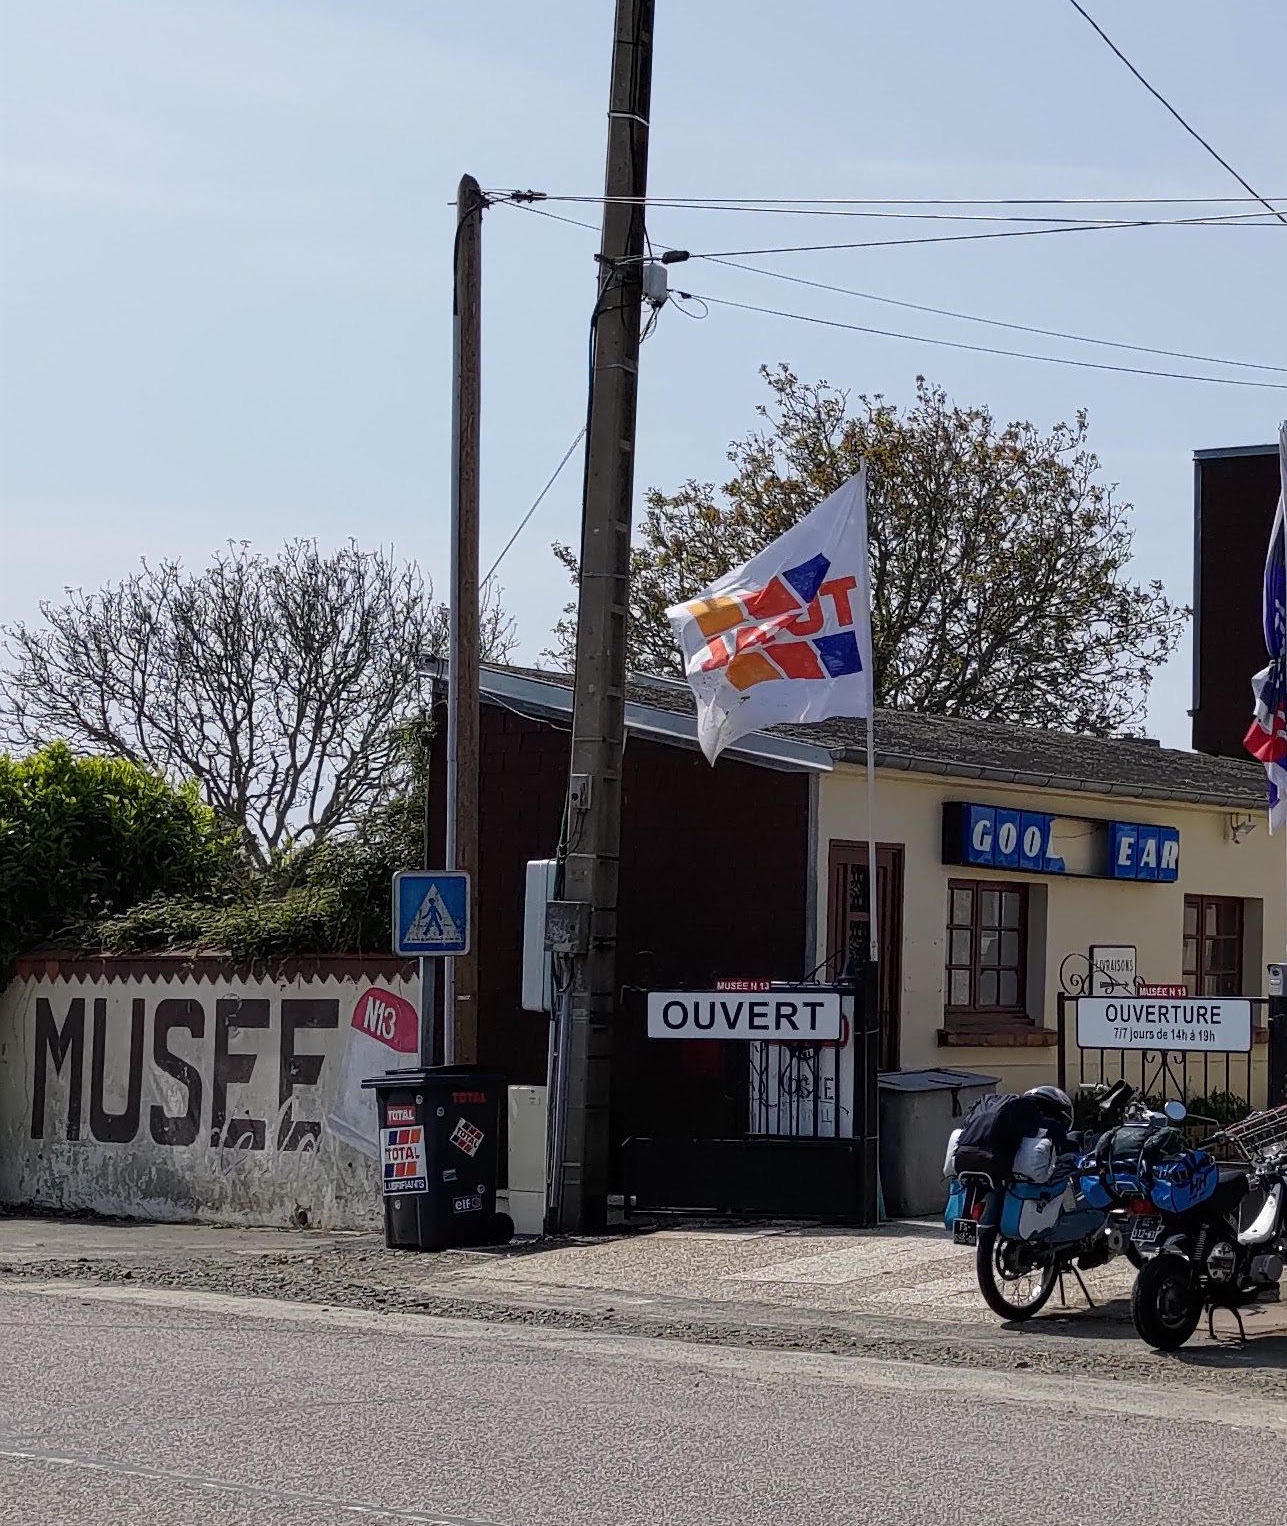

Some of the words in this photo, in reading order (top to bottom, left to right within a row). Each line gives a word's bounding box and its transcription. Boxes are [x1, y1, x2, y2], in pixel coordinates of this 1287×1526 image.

[1095, 959, 1133, 973] LIVRAISONS
[759, 982, 769, 990] 13
[364, 996, 396, 1040] N13
[662, 1000, 824, 1031] OUVERT
[1105, 1004, 1222, 1024] OUVERTURE
[1114, 1028, 1127, 1039] 7/7
[1129, 1029, 1154, 1042] jours
[1157, 1028, 1168, 1040] de
[1171, 1029, 1187, 1041] 14h
[1189, 1030, 1196, 1041] à
[1199, 1030, 1215, 1042] 19h
[452, 1092, 487, 1104] TOTAL
[387, 1109, 415, 1123] TOTAL
[385, 1146, 420, 1161] TOTAL
[455, 1196, 471, 1210] elf
